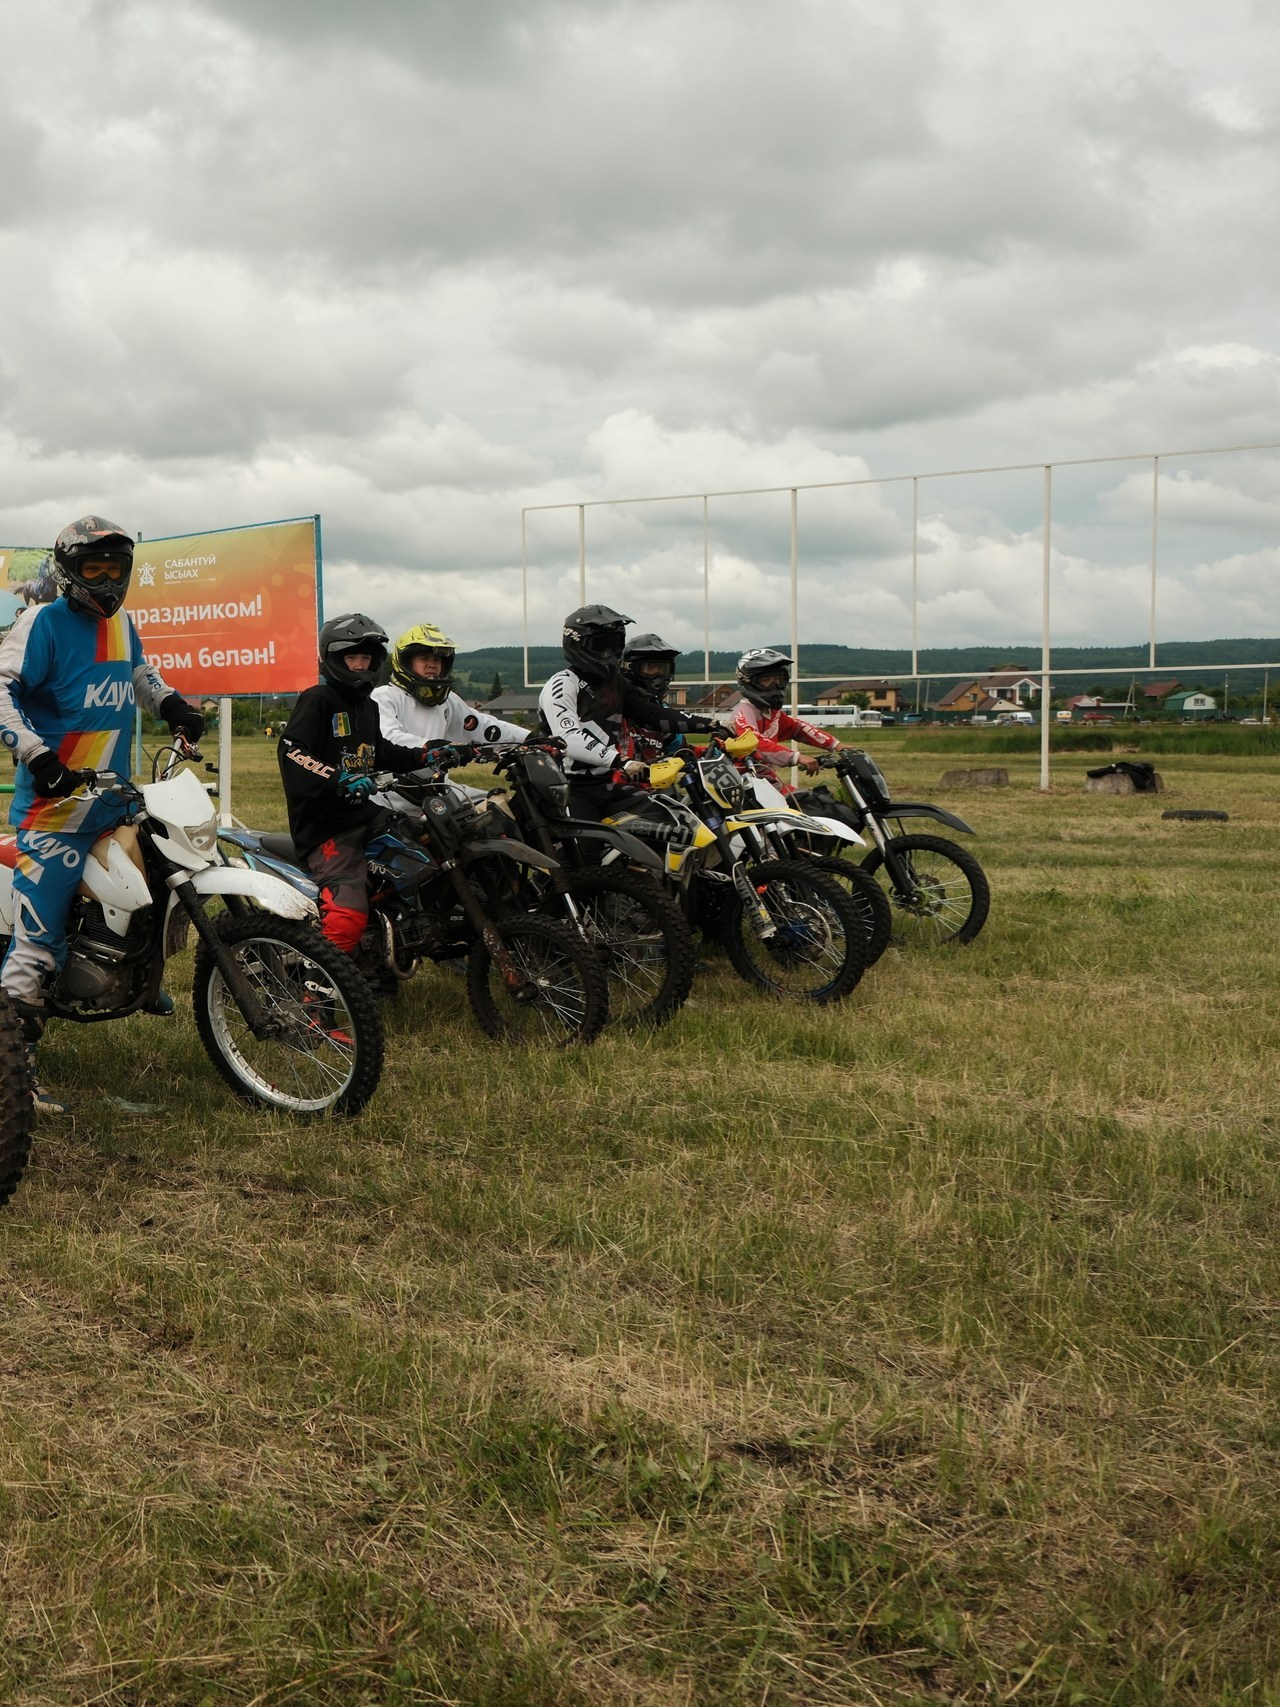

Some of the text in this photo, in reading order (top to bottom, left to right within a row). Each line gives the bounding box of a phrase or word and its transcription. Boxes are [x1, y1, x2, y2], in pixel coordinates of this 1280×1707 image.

[164, 553, 216, 569] САБАНТУЙ
[164, 569, 199, 580] ЫСЫАХ
[143, 640, 276, 670] рәм белән!
[83, 674, 135, 711] KAYO
[22, 831, 80, 868] KAYO
